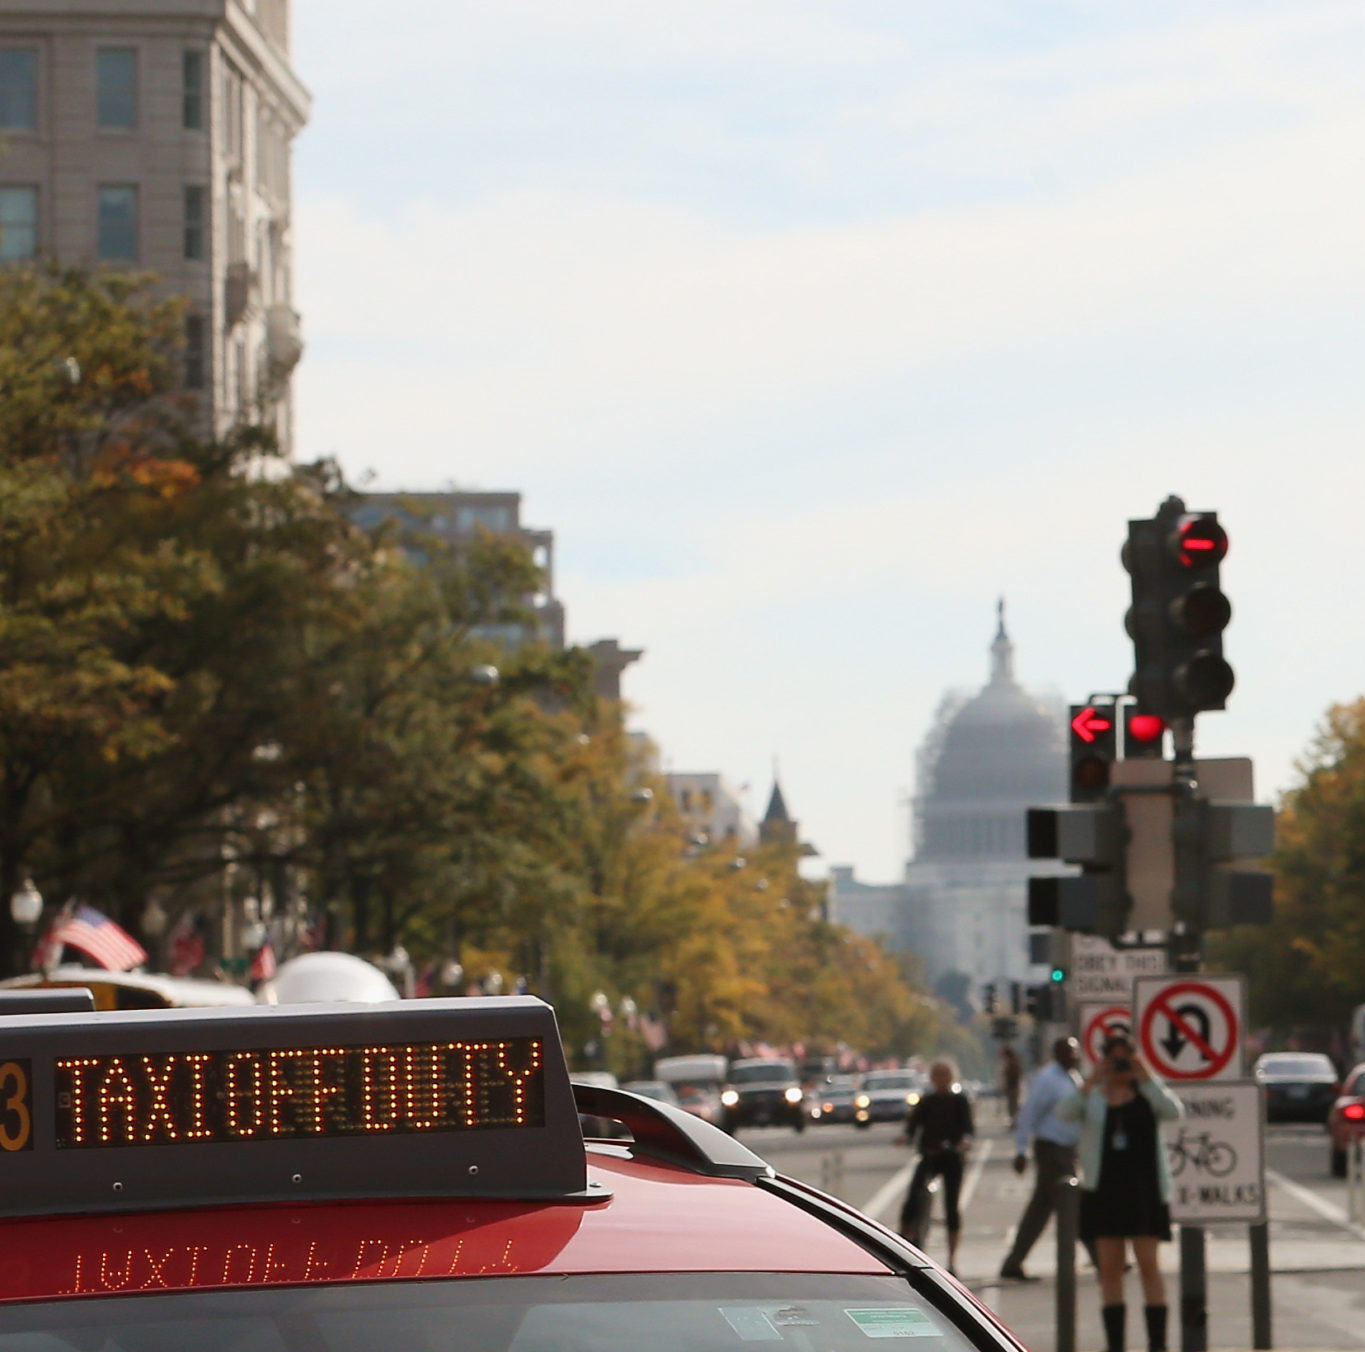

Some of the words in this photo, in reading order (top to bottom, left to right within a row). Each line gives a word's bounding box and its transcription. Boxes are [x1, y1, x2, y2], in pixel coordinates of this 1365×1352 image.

[0, 1061, 31, 1152] 3
[57, 1054, 212, 1143] TAXI
[228, 1048, 345, 1136] OFF
[363, 1041, 541, 1130] DUTY
